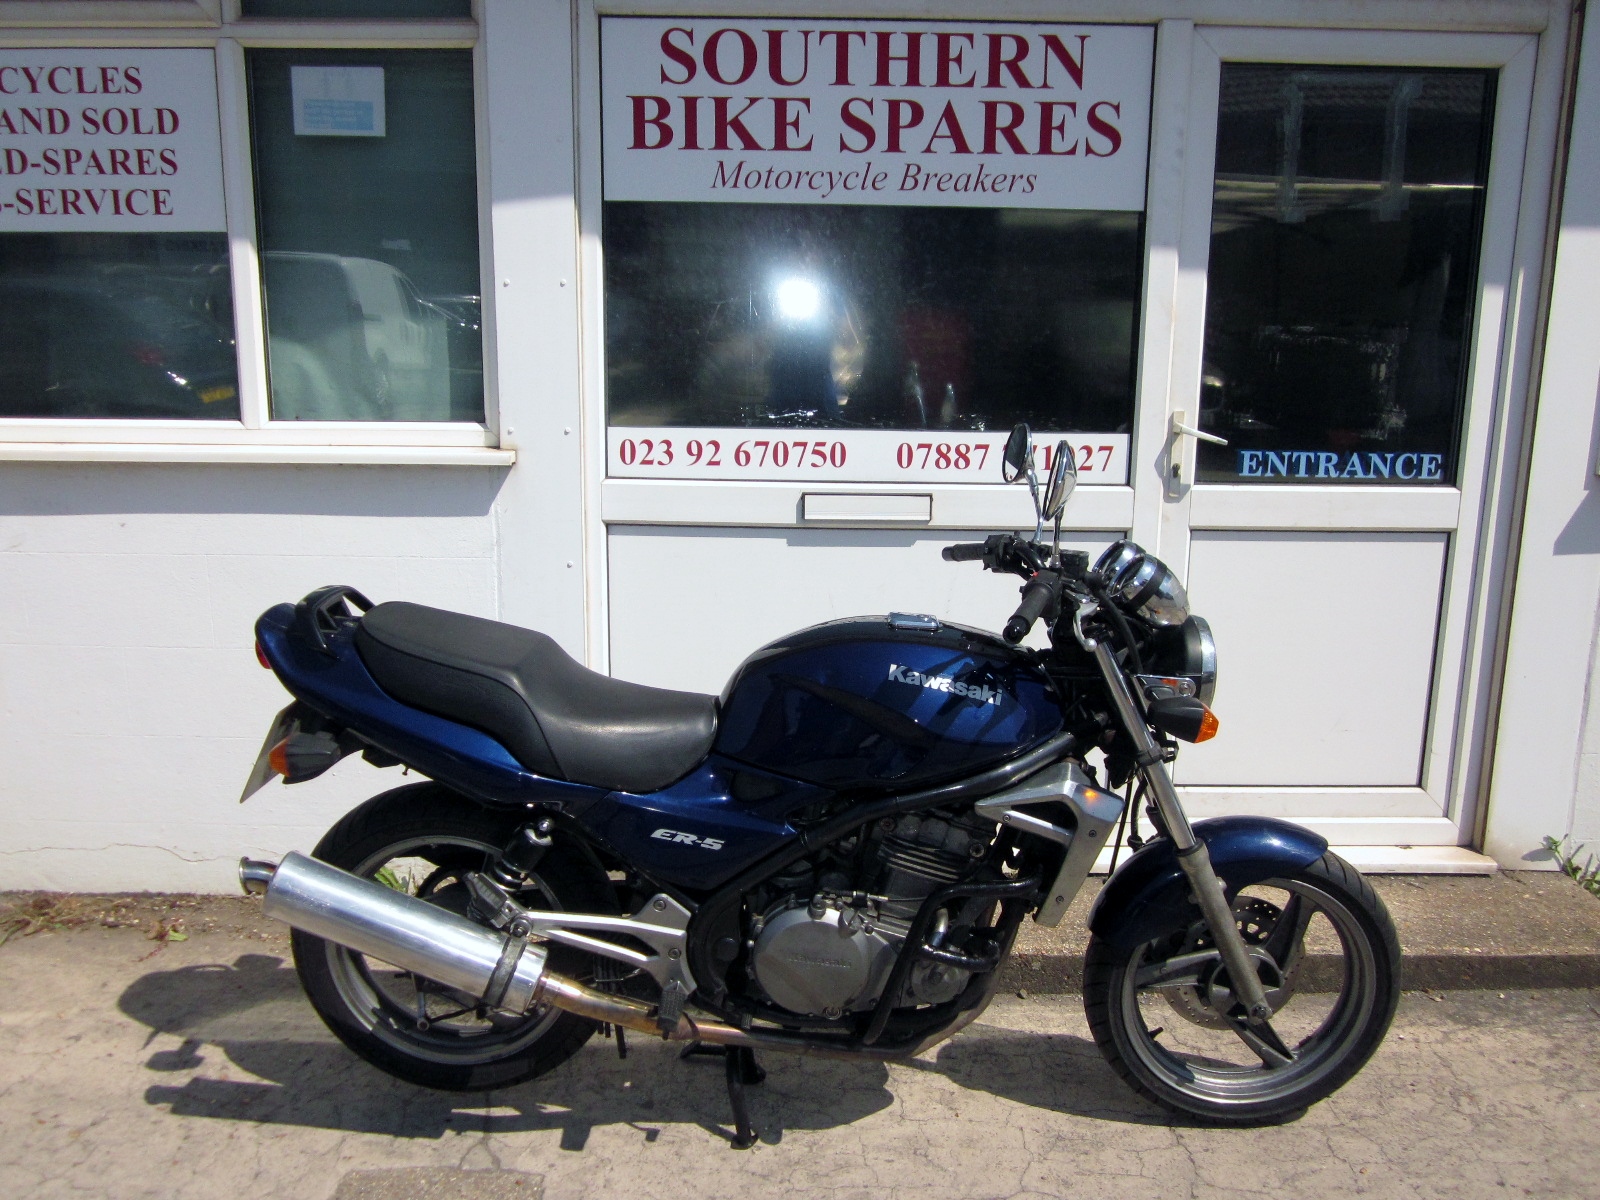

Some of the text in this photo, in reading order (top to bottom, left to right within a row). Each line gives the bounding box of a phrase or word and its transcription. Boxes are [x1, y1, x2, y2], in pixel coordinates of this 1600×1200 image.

[660, 27, 1090, 90] SOUTHERN
[0, 66, 143, 95] CYCLES
[0, 107, 180, 135] AND SOLD
[627, 95, 1122, 157] BIKE SPARES
[0, 148, 178, 176] D-SPARES
[711, 160, 1037, 198] Motorcycle Breakers
[0, 189, 174, 216] -SERVICE
[620, 438, 847, 468] 023 92 670750
[896, 442, 1114, 471] 07887 127
[1239, 450, 1442, 480] ENTRANCE
[888, 663, 1002, 706] Kawasaki
[650, 828, 726, 851] ER-5
